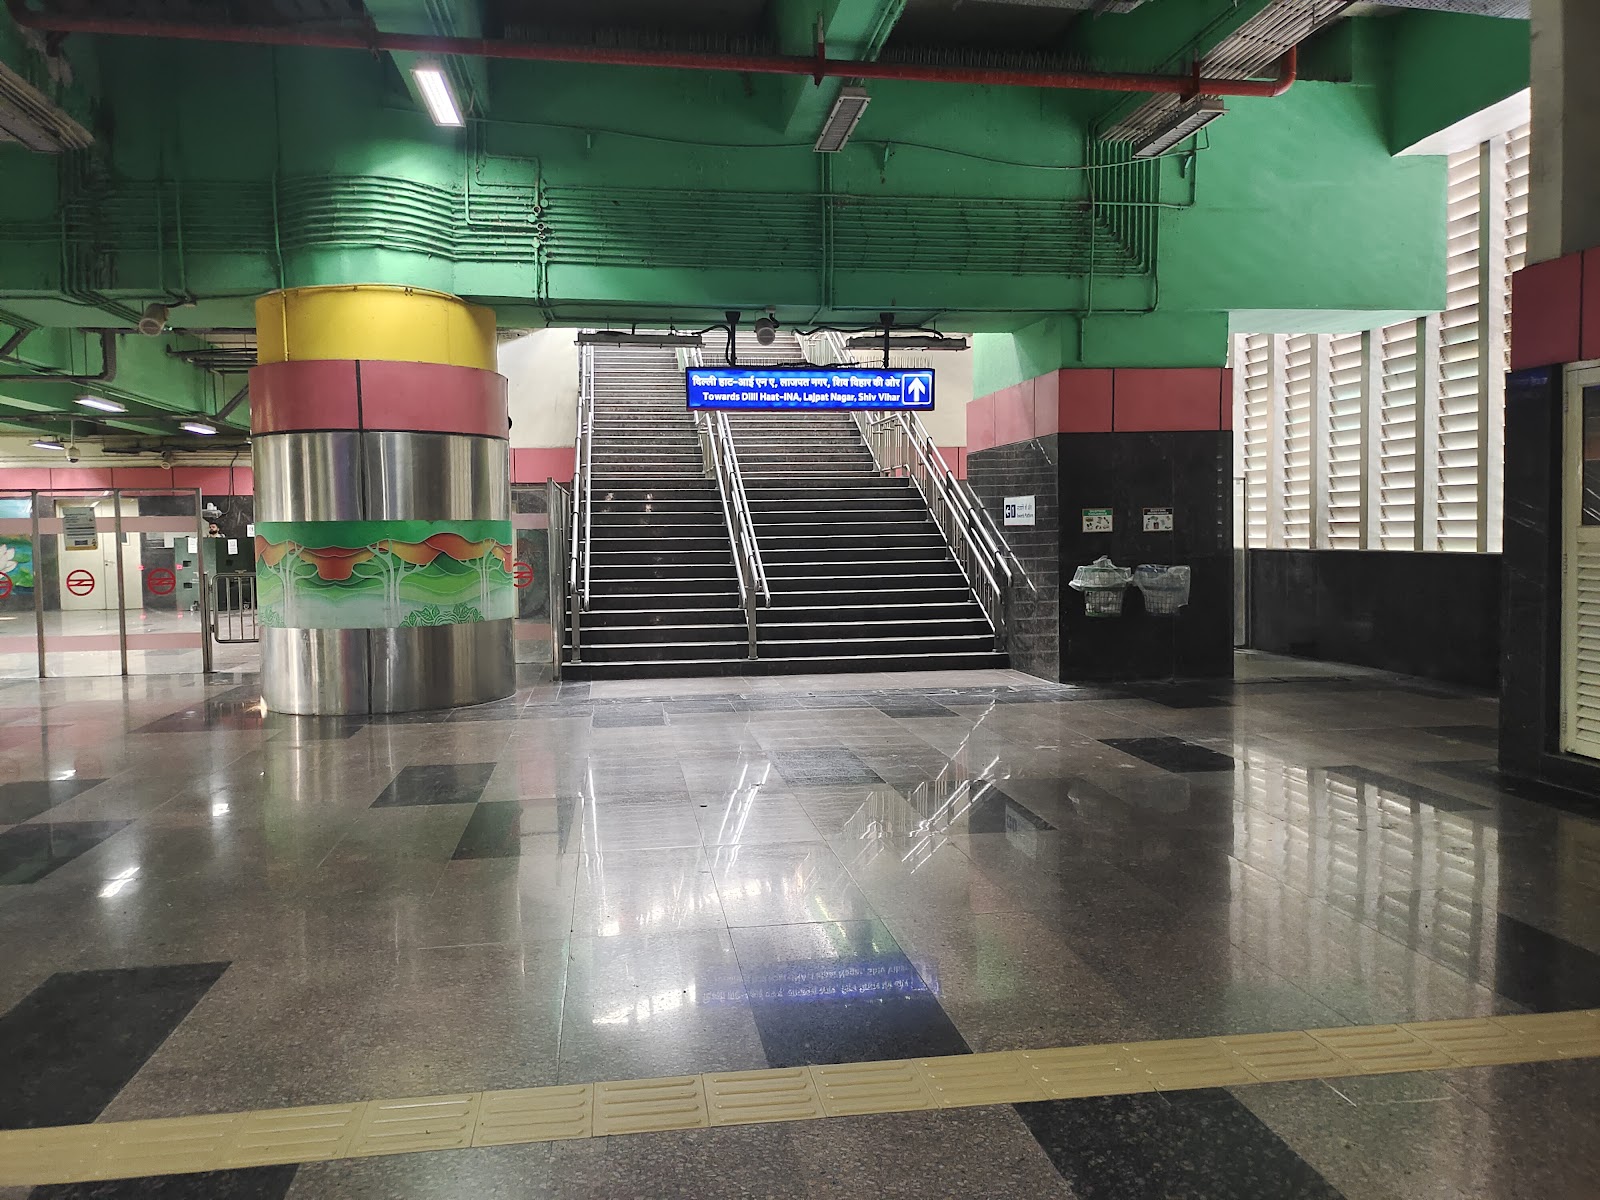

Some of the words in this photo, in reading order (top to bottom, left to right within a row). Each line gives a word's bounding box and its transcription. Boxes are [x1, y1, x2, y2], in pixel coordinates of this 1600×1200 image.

[692, 374, 717, 387] दिल्ली
[755, 377, 768, 388] एन
[779, 377, 811, 387] लाजपत
[832, 375, 850, 387] शिव
[850, 375, 872, 387] विहार
[873, 376, 884, 387] की
[884, 376, 901, 387] ओर
[702, 391, 740, 401] Towards
[803, 392, 829, 403] Lajpat
[830, 392, 857, 403] Nagar,
[858, 392, 877, 402] Shiv
[878, 392, 901, 402] Vihar
